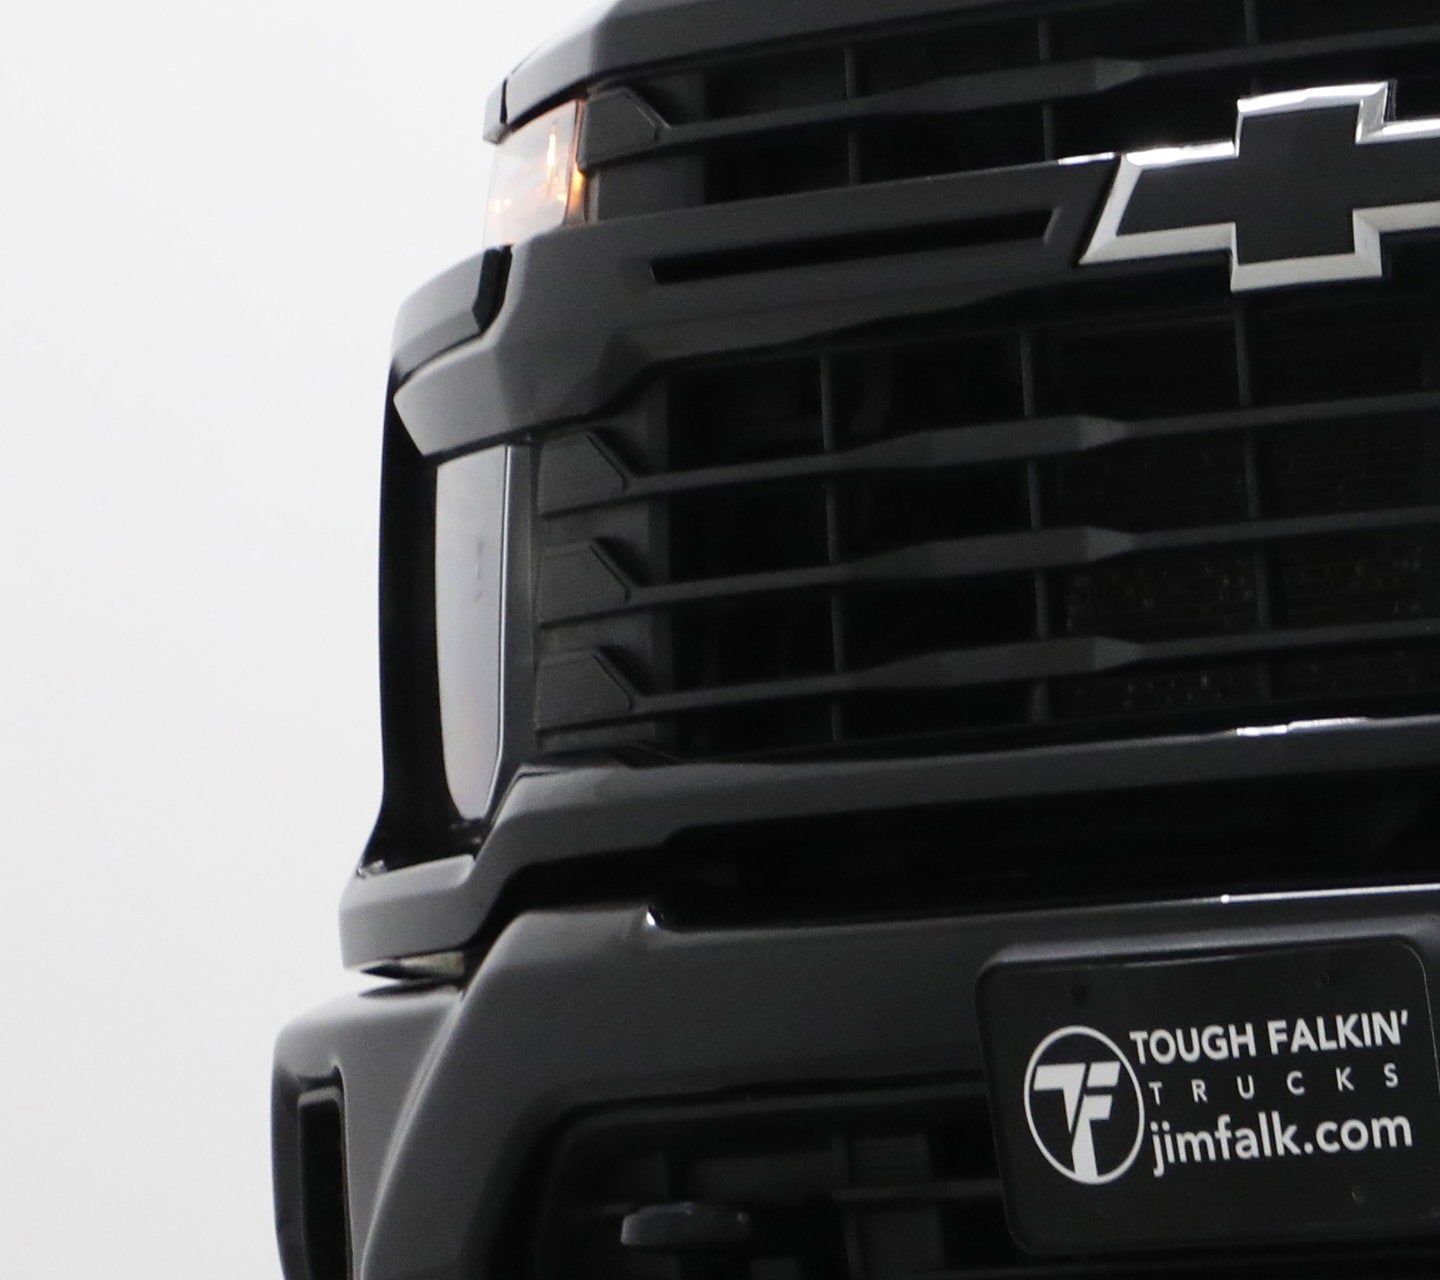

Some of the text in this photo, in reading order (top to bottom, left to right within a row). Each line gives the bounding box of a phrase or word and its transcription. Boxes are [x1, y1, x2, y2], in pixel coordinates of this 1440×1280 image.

[1128, 1009, 1409, 1066] TOUGH FALKIN'
[1148, 1062, 1399, 1106] TRUCKS
[1150, 1110, 1413, 1178] jimfalk.com
